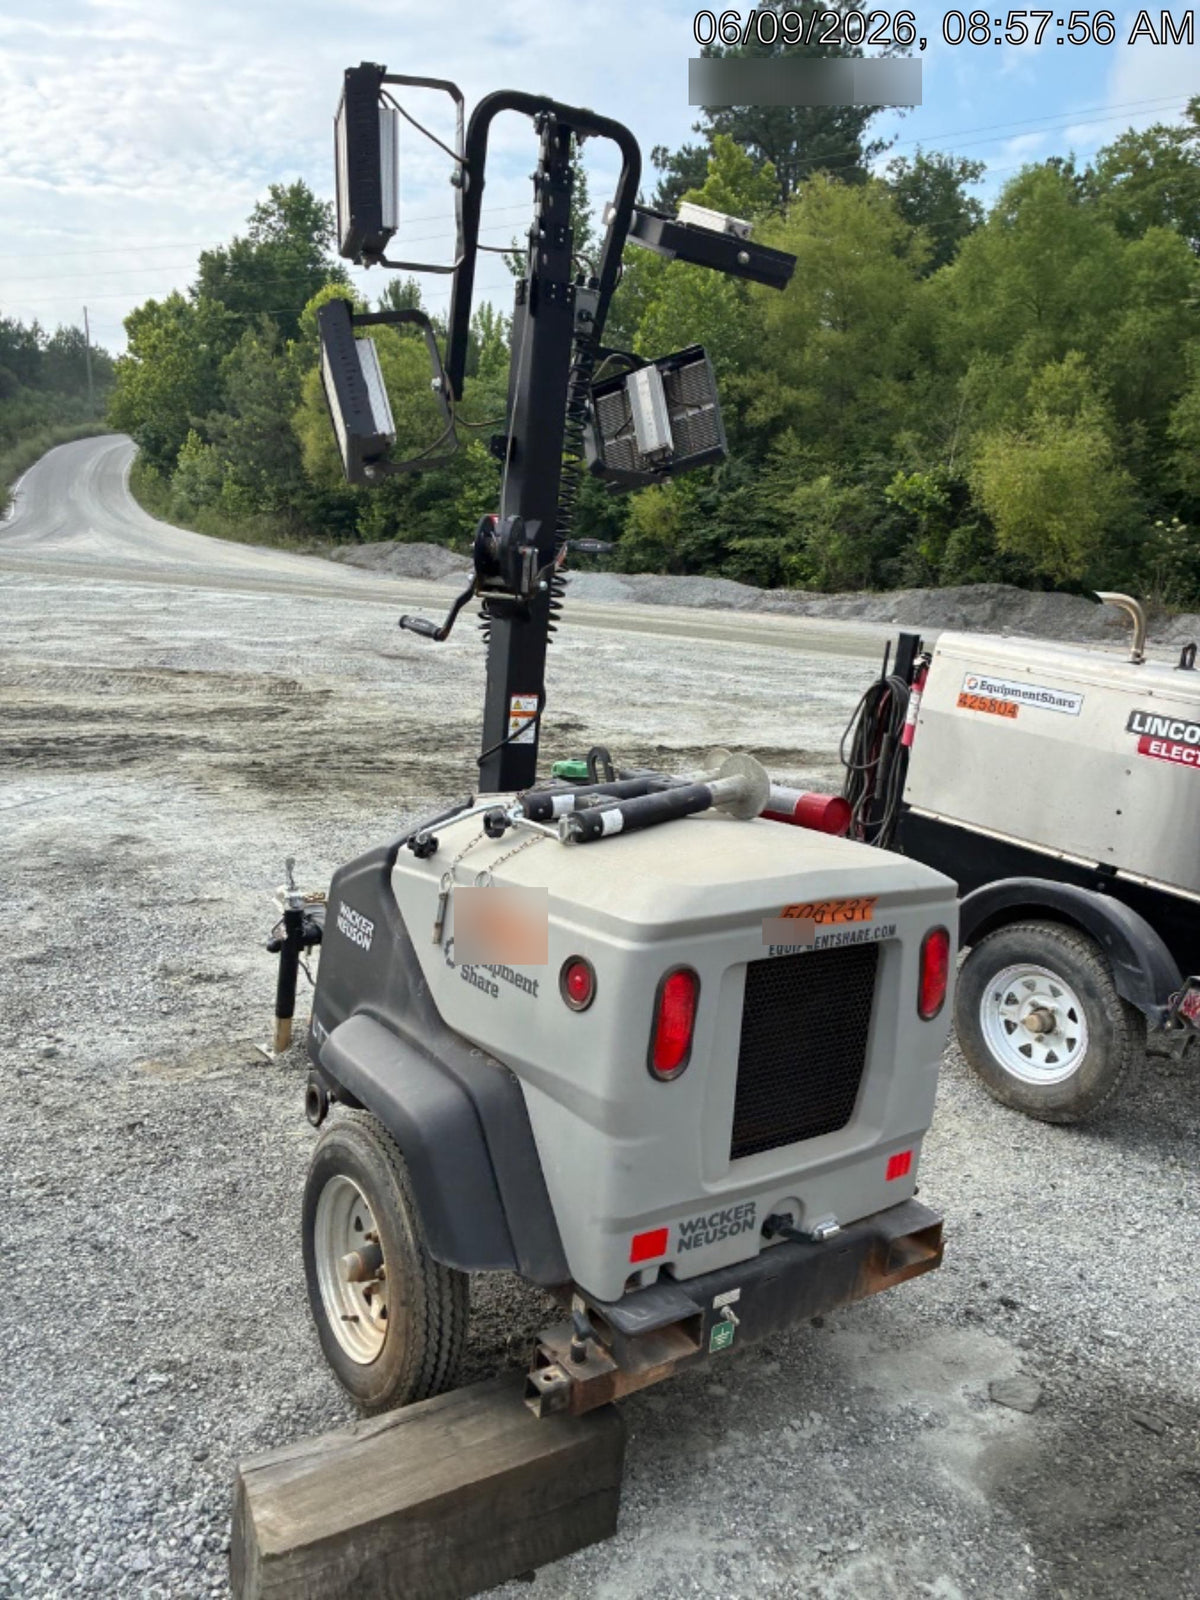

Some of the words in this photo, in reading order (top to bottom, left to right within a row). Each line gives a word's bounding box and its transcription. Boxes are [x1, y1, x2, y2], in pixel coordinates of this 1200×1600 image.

[959, 693, 1018, 718] 425804
[980, 680, 1076, 709] EquipmentShare
[336, 914, 372, 951] NEUSON
[340, 900, 374, 937] WACKER
[460, 964, 499, 999] Share
[677, 1215, 756, 1254] NEUSON
[679, 1201, 757, 1236] WACKER
